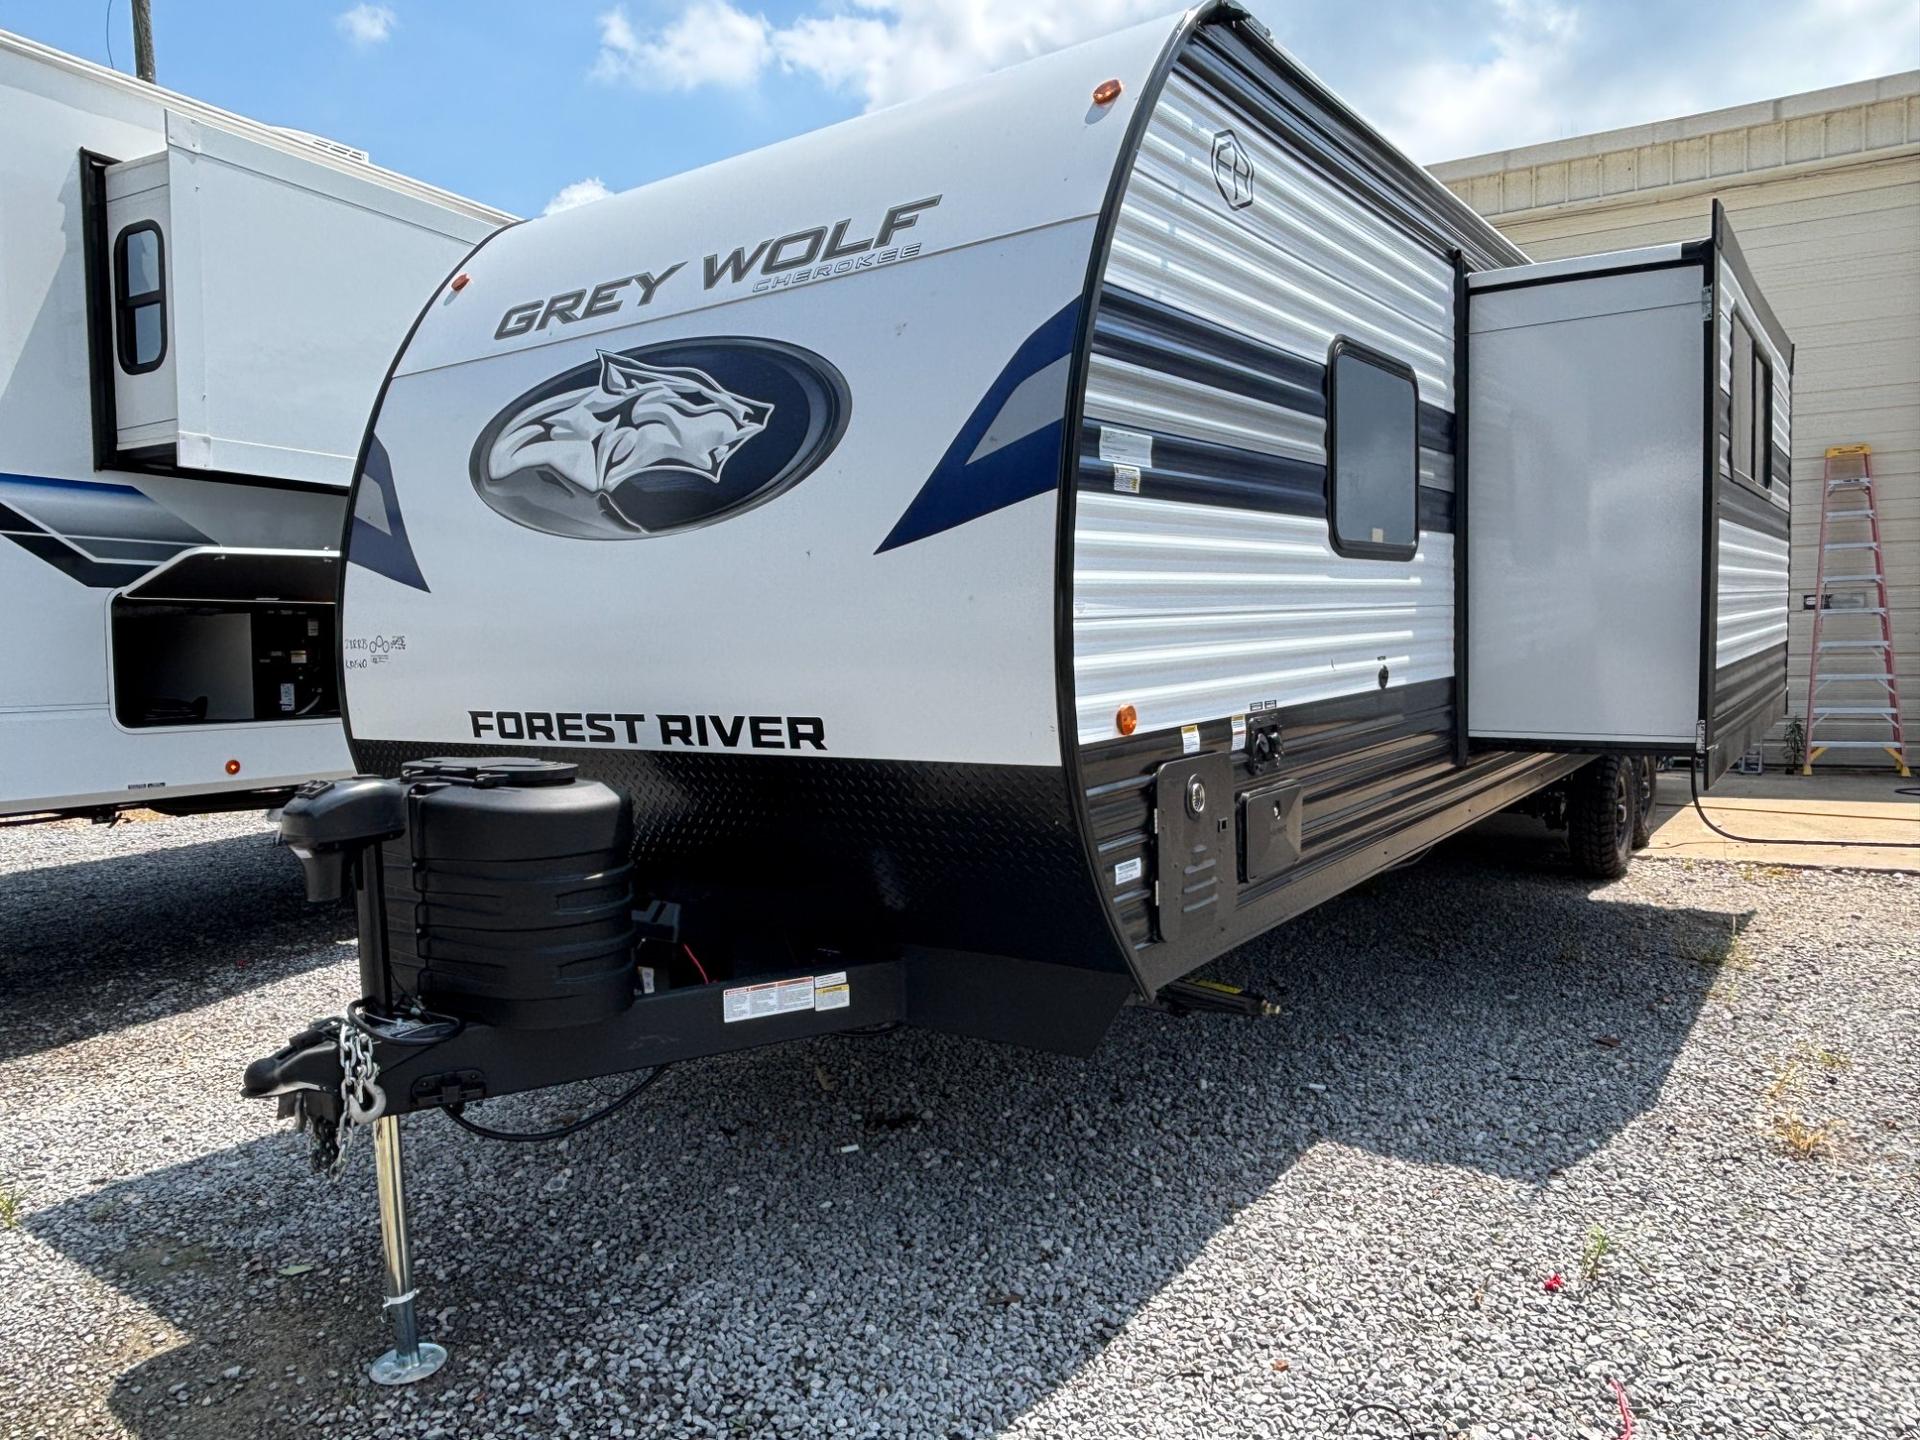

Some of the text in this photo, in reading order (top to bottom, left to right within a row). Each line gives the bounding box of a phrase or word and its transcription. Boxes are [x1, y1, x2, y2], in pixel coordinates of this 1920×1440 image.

[494, 194, 943, 340] GREY WOLF
[752, 242, 922, 293] CHEROKEE
[467, 710, 828, 751] FOREST RIVER
